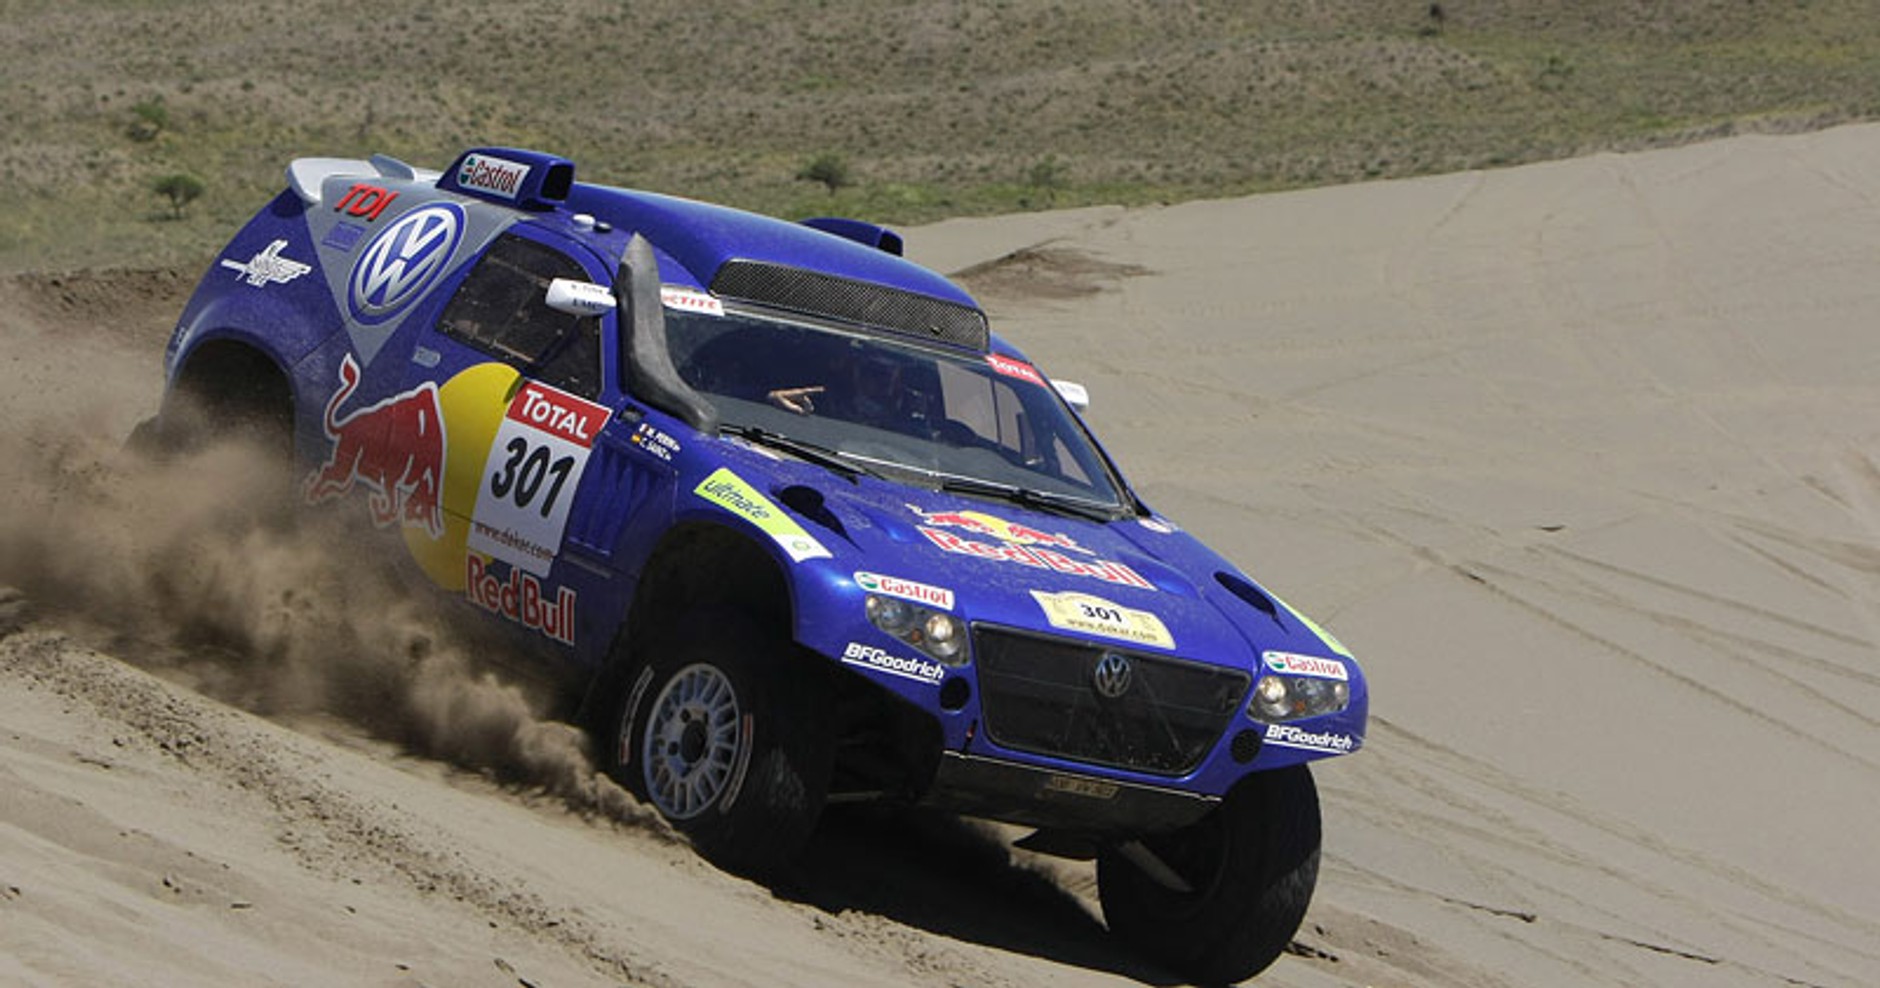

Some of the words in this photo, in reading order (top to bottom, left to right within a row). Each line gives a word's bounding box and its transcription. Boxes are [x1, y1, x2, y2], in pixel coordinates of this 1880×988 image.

[470, 160, 522, 194] Castrol
[334, 183, 400, 222] TDI
[522, 389, 589, 439] TOTAL
[491, 437, 575, 518] 301
[704, 479, 770, 519] ultimate
[915, 525, 1050, 570] Red
[1023, 546, 1158, 591] Bull
[466, 548, 520, 622] Red
[522, 573, 577, 647] Bull
[881, 578, 949, 606] Castrol
[1081, 603, 1123, 623] 301
[844, 643, 944, 680] BFGoodrich
[1285, 656, 1343, 676] Castrol
[1266, 724, 1353, 749] BFGoodrich
